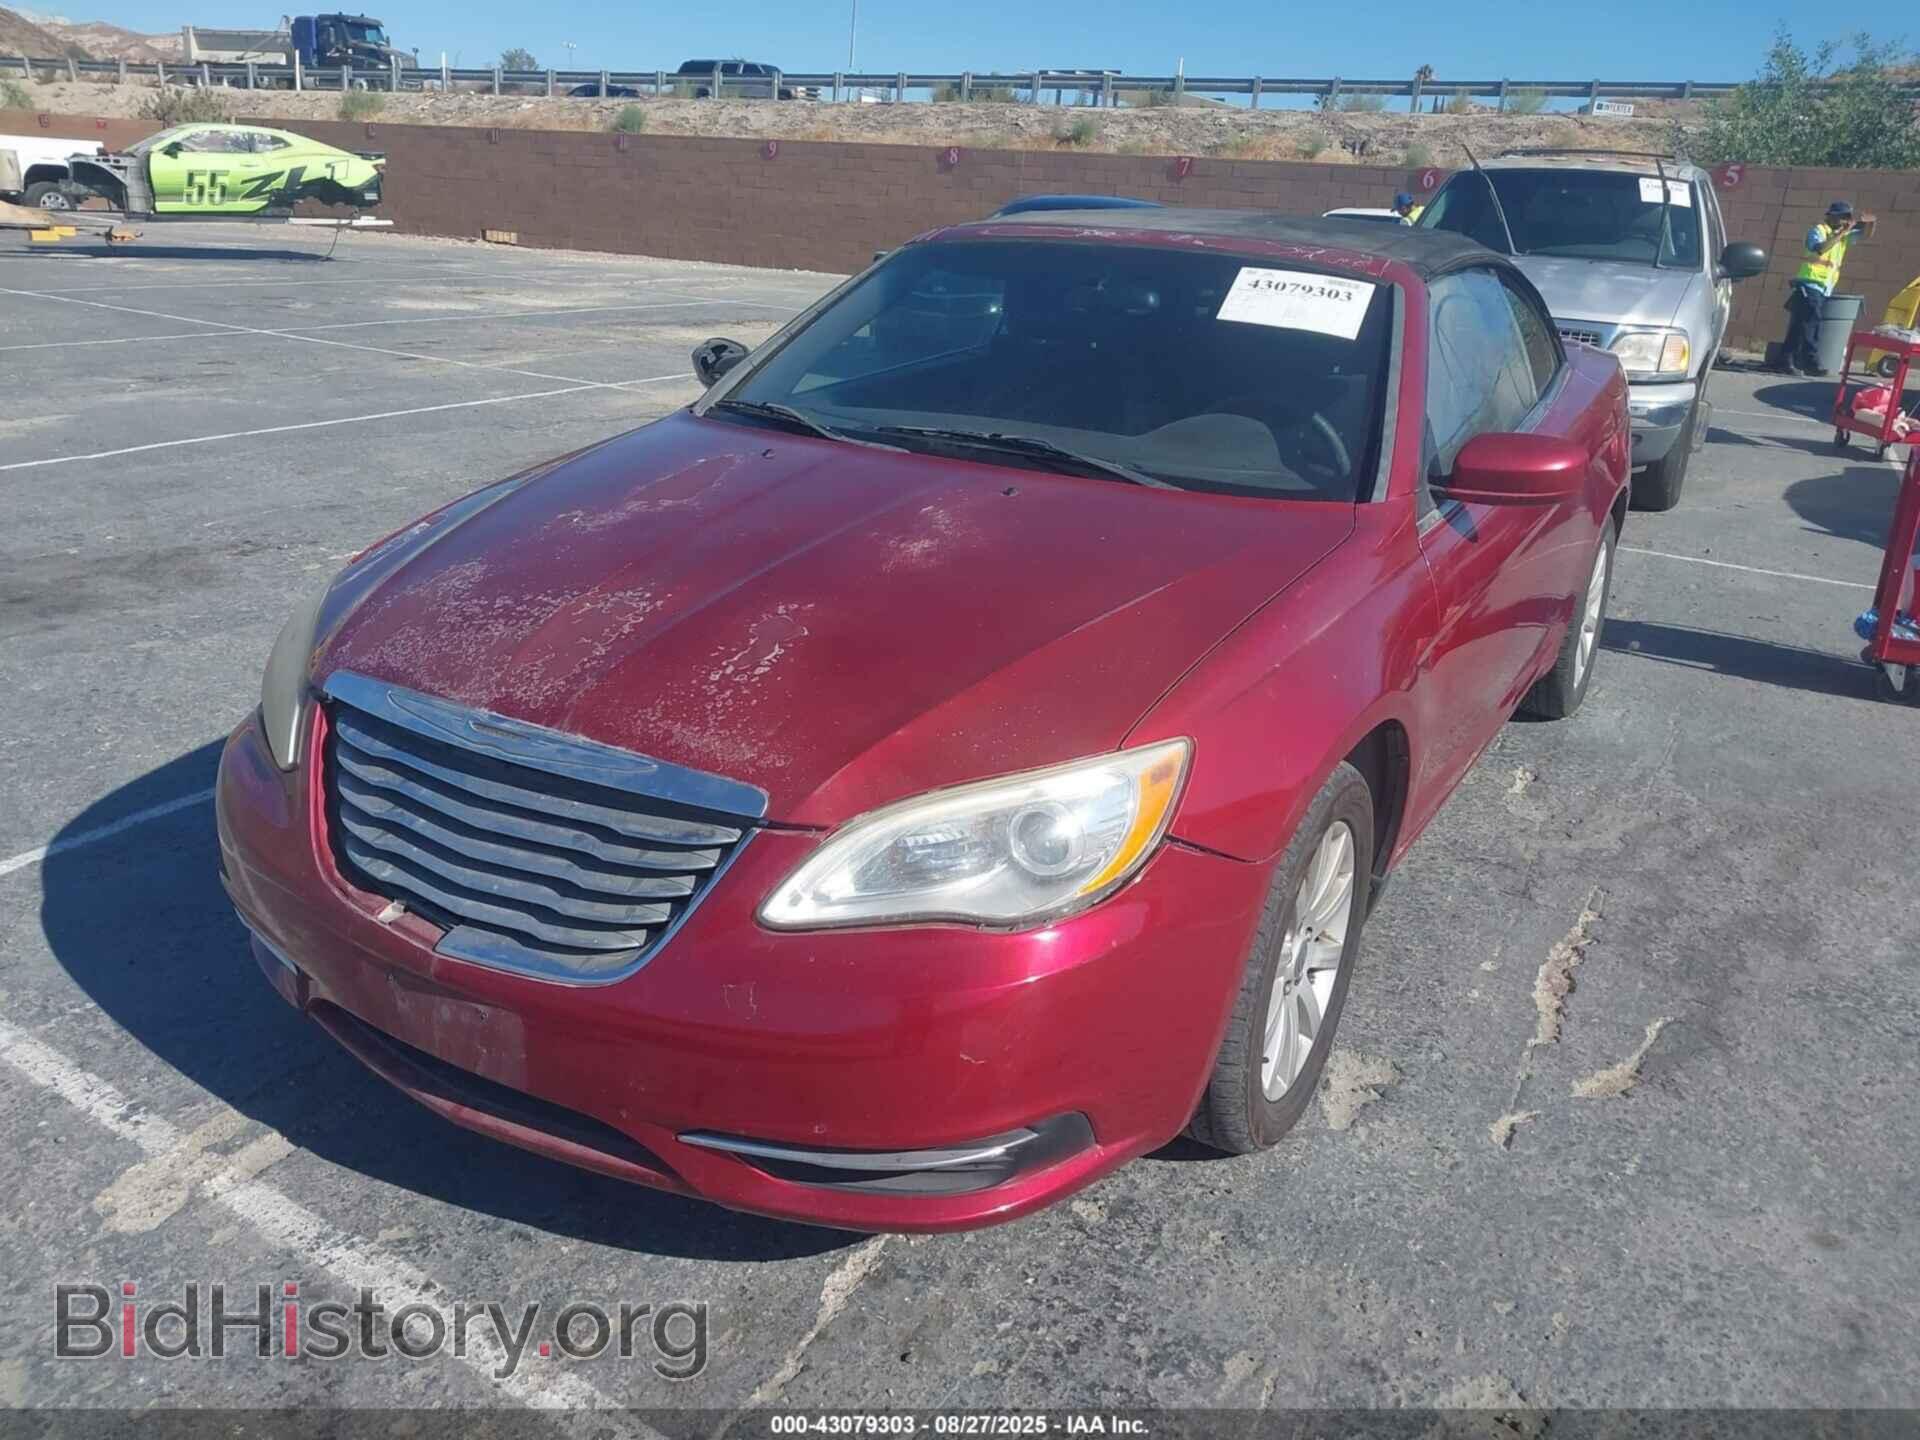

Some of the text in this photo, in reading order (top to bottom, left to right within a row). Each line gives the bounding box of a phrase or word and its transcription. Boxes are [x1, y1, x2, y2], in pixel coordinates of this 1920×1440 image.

[769, 140, 777, 158] 9
[950, 147, 959, 165] 8
[1180, 157, 1191, 176] 7
[1723, 164, 1741, 186] 5
[183, 169, 230, 206] 55
[1423, 169, 1434, 189] 6
[1248, 279, 1353, 302] 43079303
